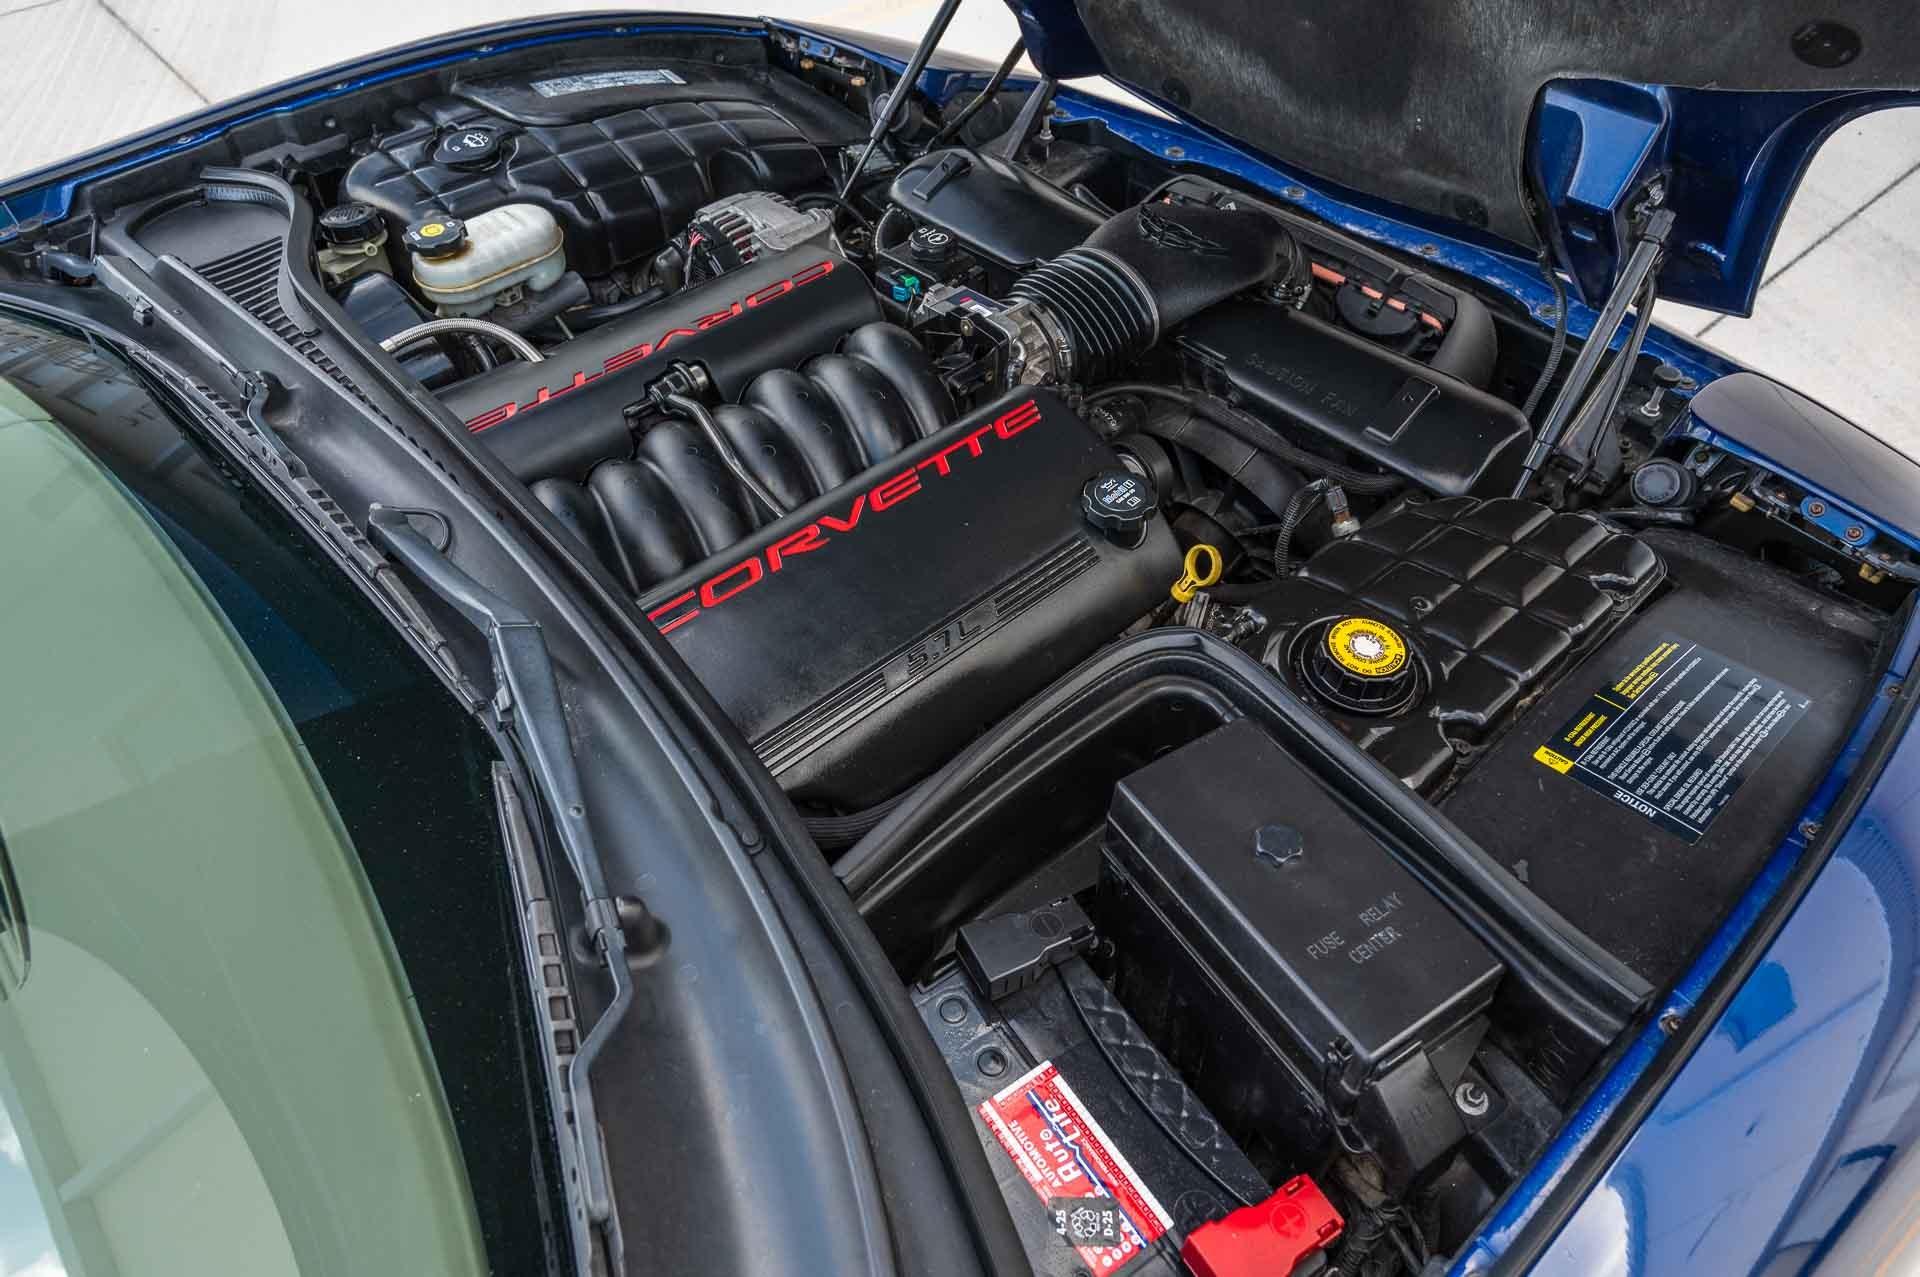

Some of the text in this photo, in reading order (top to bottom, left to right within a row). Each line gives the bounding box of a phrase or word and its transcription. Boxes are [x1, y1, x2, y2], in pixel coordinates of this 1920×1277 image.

[465, 260, 835, 432] CORVETTE
[648, 399, 1042, 635] CORVETTE
[907, 620, 985, 676] 5.7L
[1614, 790, 1656, 817] NOTICE
[1306, 891, 1403, 960] FUSE RELAY
[1348, 926, 1403, 964] CENTER
[1045, 1099, 1080, 1145] Life
[1008, 1119, 1063, 1187] AUTOMOTIVE
[1040, 1128, 1082, 1183] Auto
